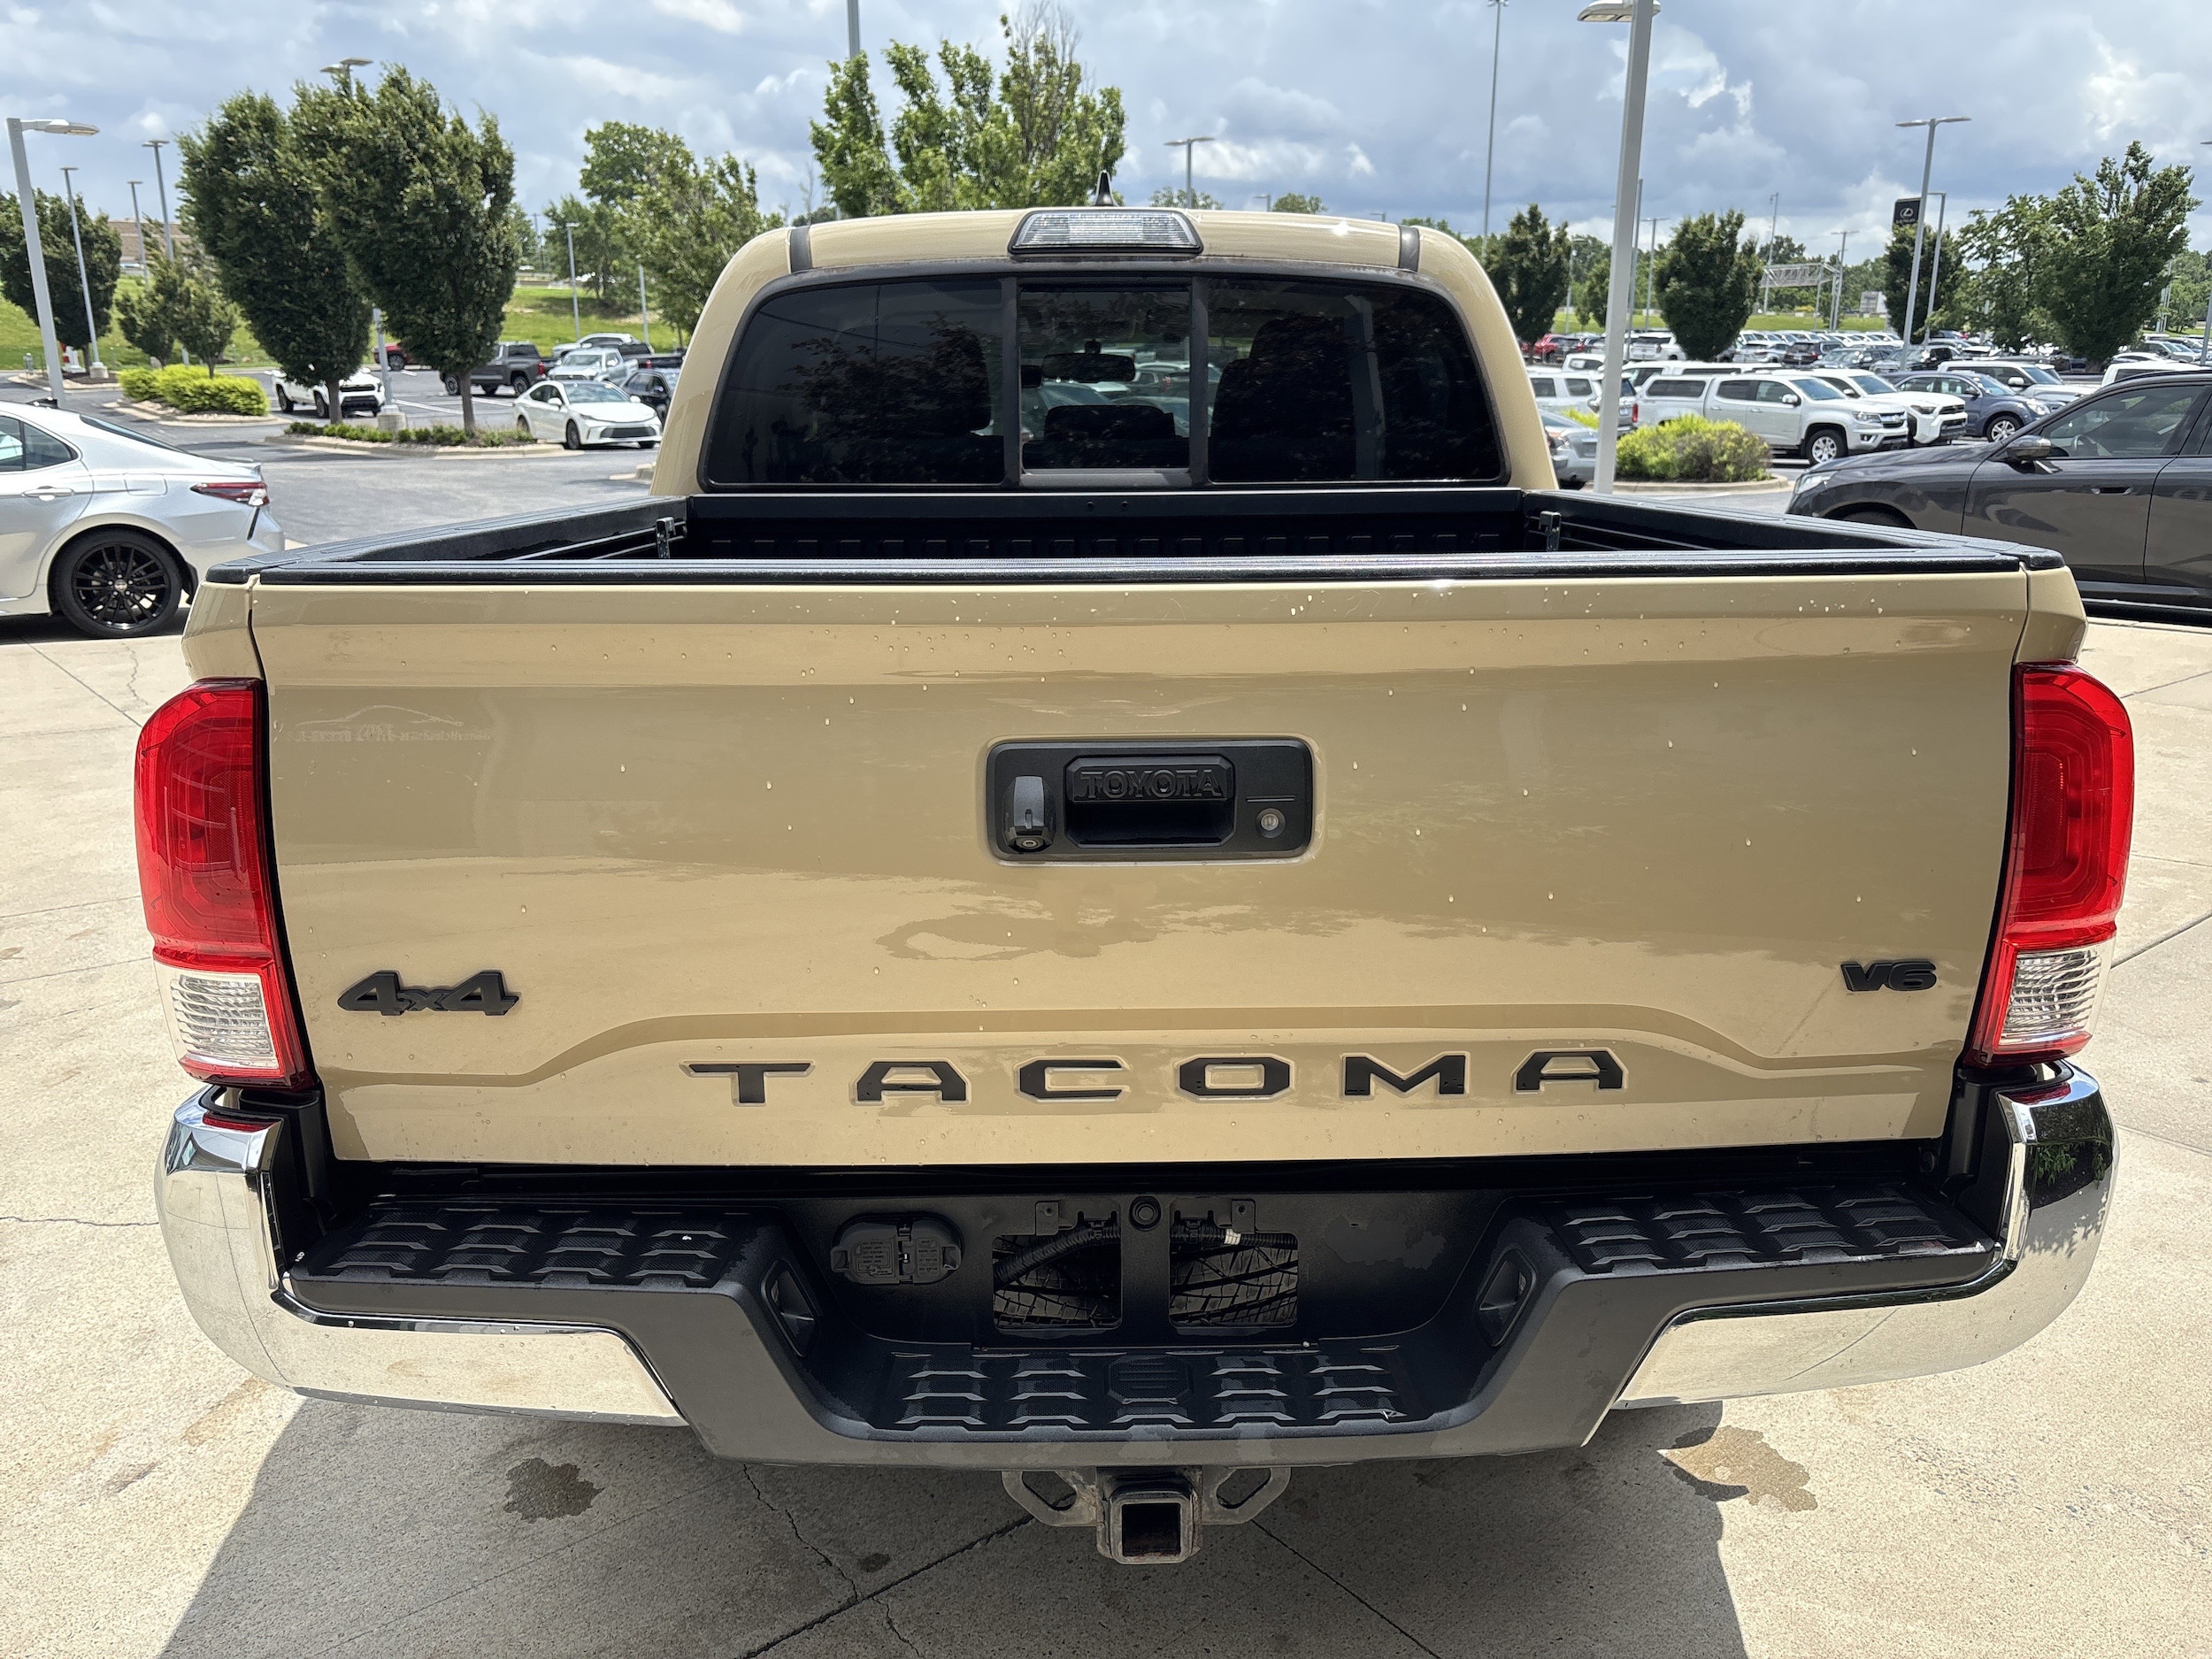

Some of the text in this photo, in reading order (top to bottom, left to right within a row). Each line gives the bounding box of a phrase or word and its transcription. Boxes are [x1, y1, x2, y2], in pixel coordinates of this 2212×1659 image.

[1079, 769, 1223, 799] TOYOTA
[337, 970, 519, 1016] 4x4
[1840, 961, 1937, 992] V6
[683, 1050, 1625, 1104] TACOMA
